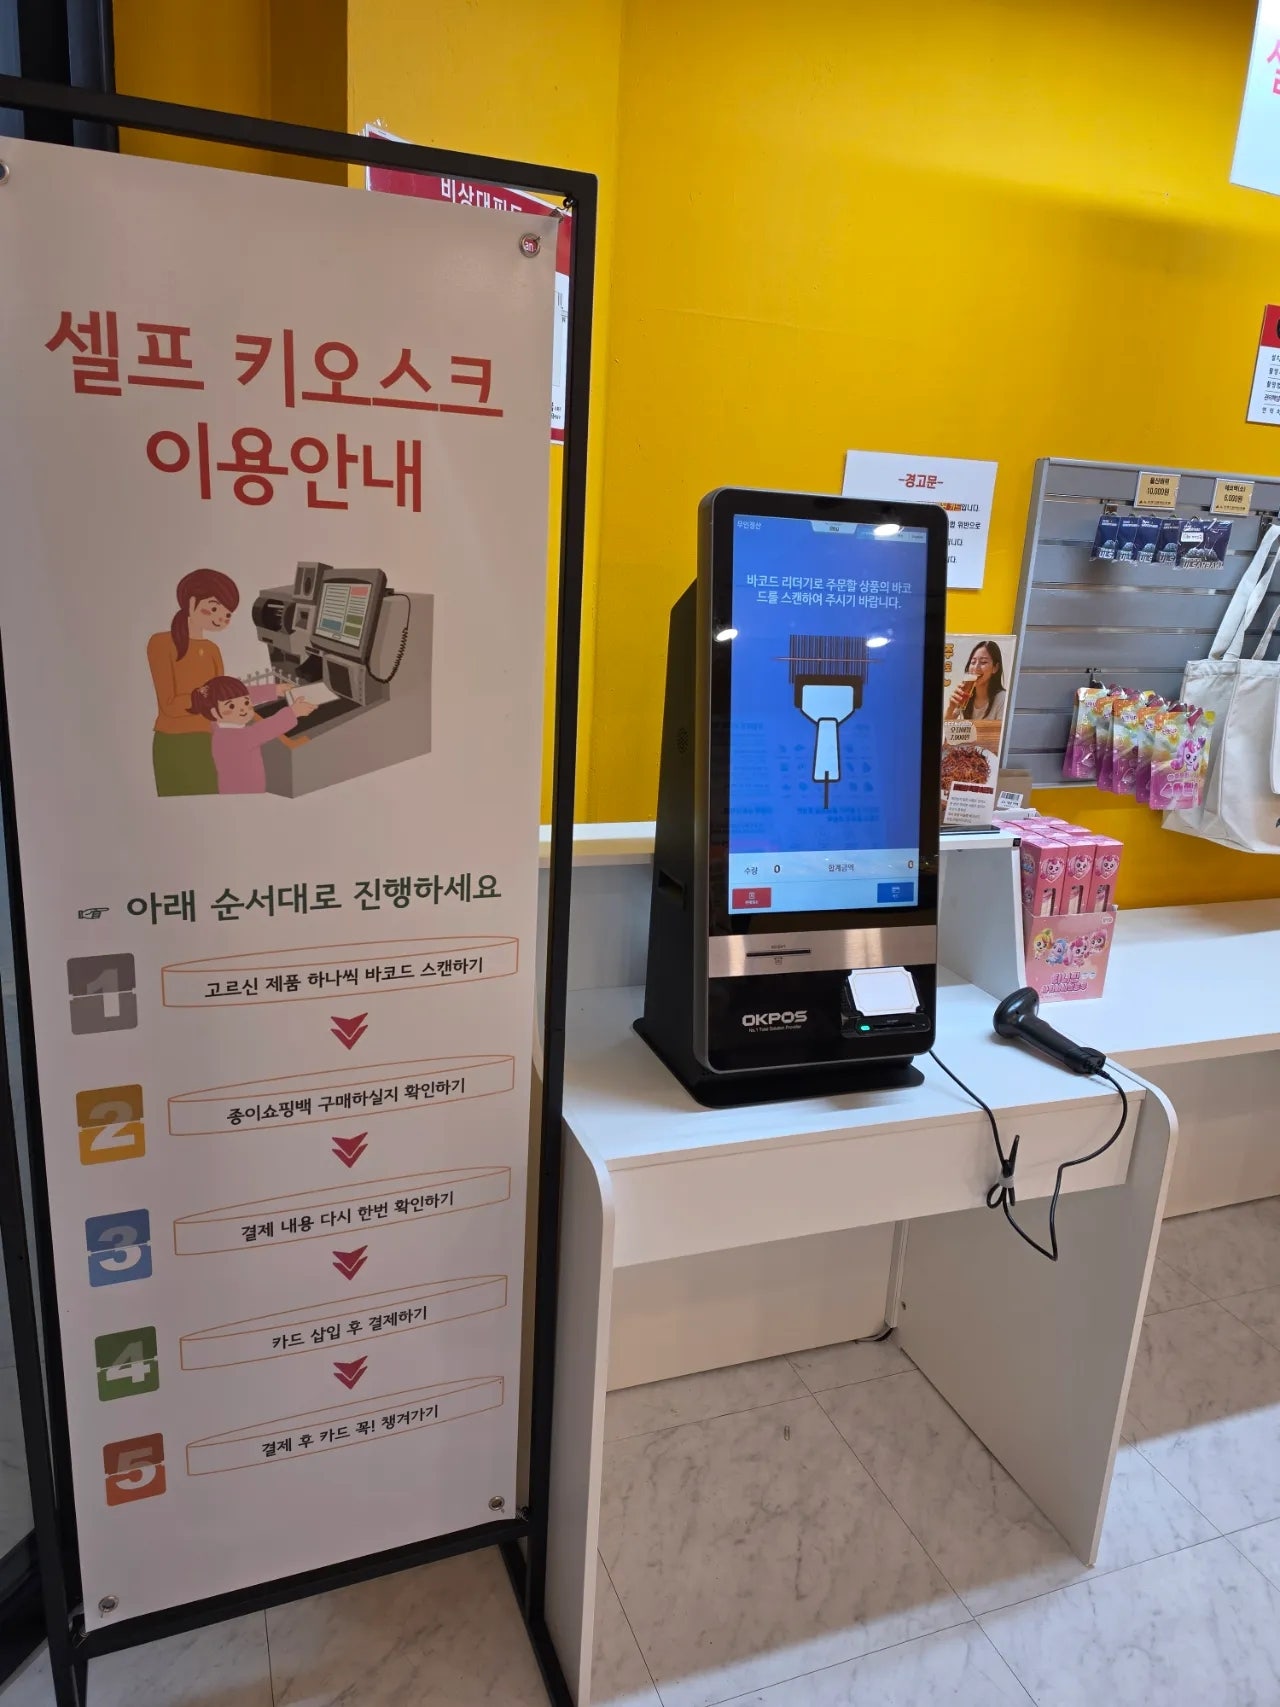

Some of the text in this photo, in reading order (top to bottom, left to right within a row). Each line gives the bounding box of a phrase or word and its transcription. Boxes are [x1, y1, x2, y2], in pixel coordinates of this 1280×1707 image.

[46, 311, 503, 417] 셀프 키오스크
[146, 422, 422, 513] 이용안내
[747, 574, 912, 595] 바코드 리더기로 주문할 상품의 바코
[756, 591, 902, 609] 드를 스캔하여 주시기 바랍니다.
[744, 860, 914, 876] 수량 0 합계금액 0
[126, 872, 502, 925] 아래 순서대로 진행하세요
[86, 968, 120, 1018] 1
[204, 957, 484, 998] 고르신 제품 하나씩 바코드 스캔하기
[742, 1010, 808, 1026] OKPOS
[226, 1077, 466, 1125] 종이쇼핑백 구매하실지 확인하기
[90, 1100, 135, 1151] 2
[241, 1191, 454, 1243] 결제 내용 다시 한번 확인하기
[98, 1225, 141, 1272] 3
[272, 1306, 428, 1351] 카드 삽입 후 결제하기
[105, 1341, 150, 1384] 4
[261, 1404, 439, 1458] 결제 후 카드 꼭! 챙겨가기
[115, 1447, 157, 1491] 5
